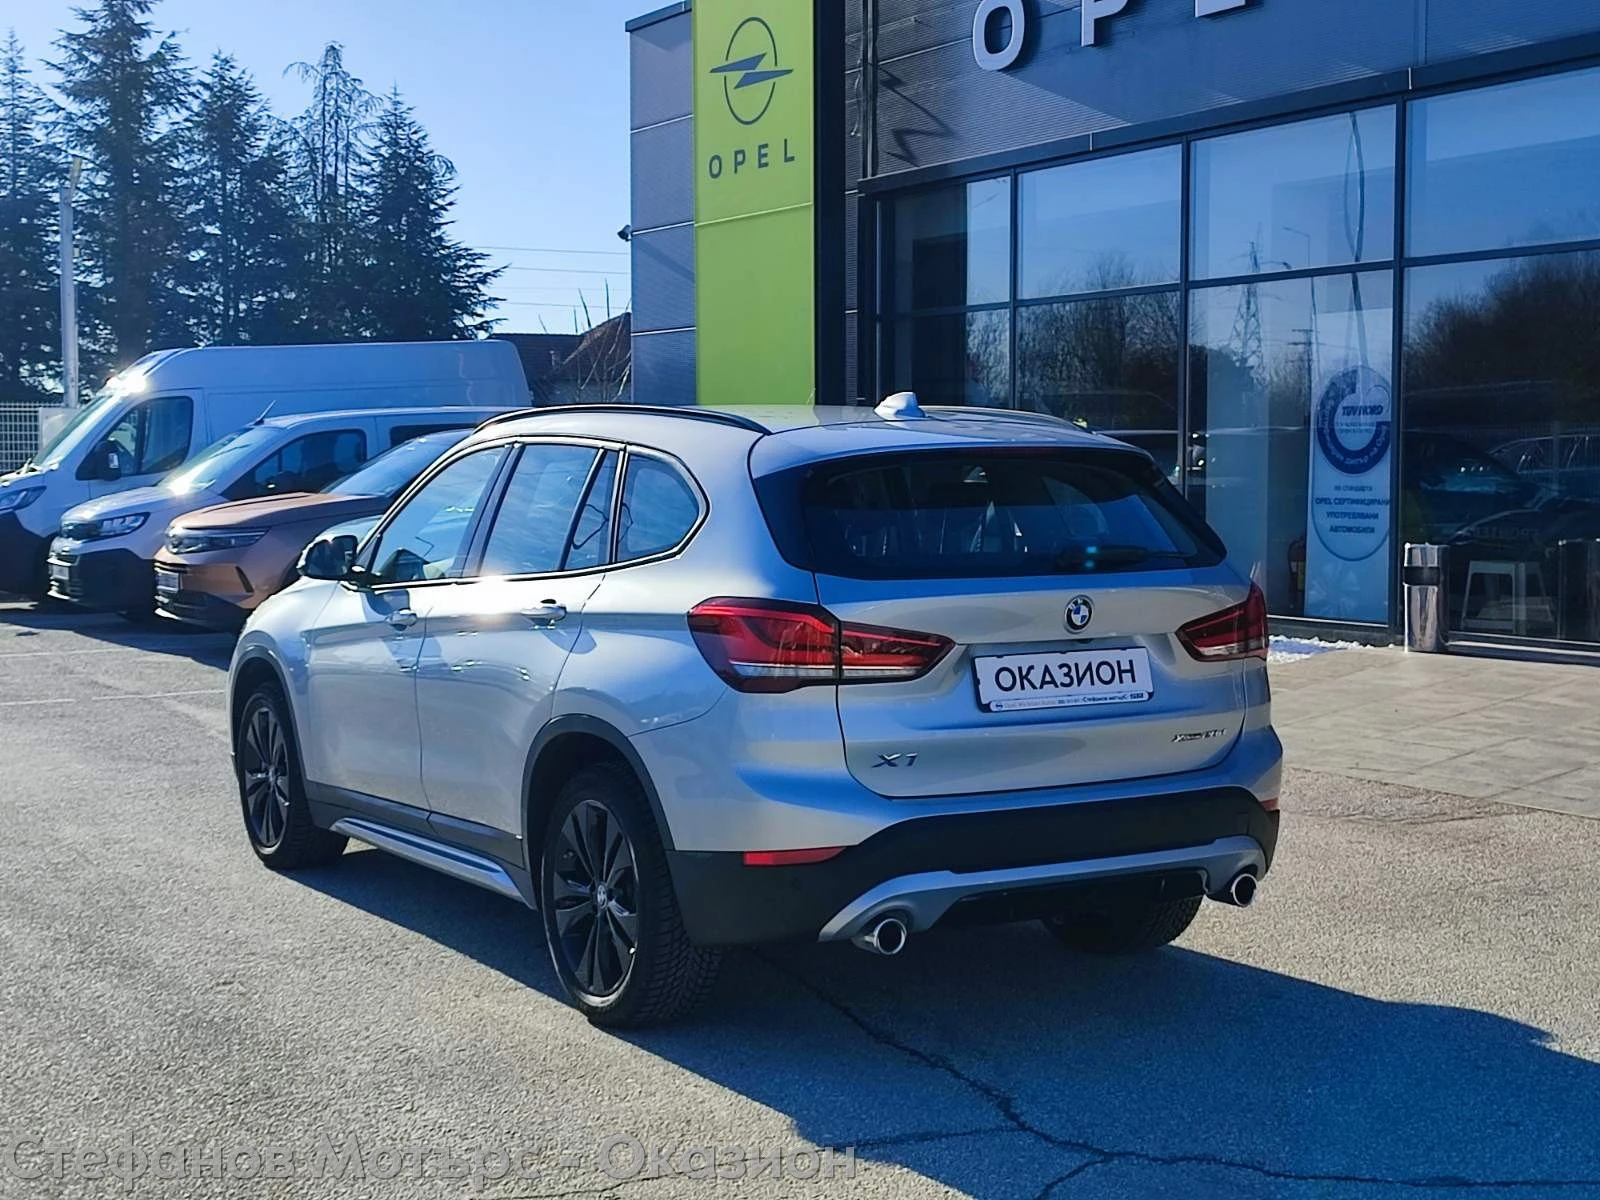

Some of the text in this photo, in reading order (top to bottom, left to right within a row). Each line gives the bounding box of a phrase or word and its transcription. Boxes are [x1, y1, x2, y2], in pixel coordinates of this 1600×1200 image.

[972, 0, 1246, 71] OP
[708, 138, 796, 180] OPEL
[1315, 497, 1332, 505] OPEL
[1326, 511, 1379, 520] УПОТРЕБЯВАНИ
[1329, 525, 1375, 534] АВТОМОБИЛИ
[994, 658, 1136, 692] ОКАЗИОН
[871, 752, 918, 768] X1
